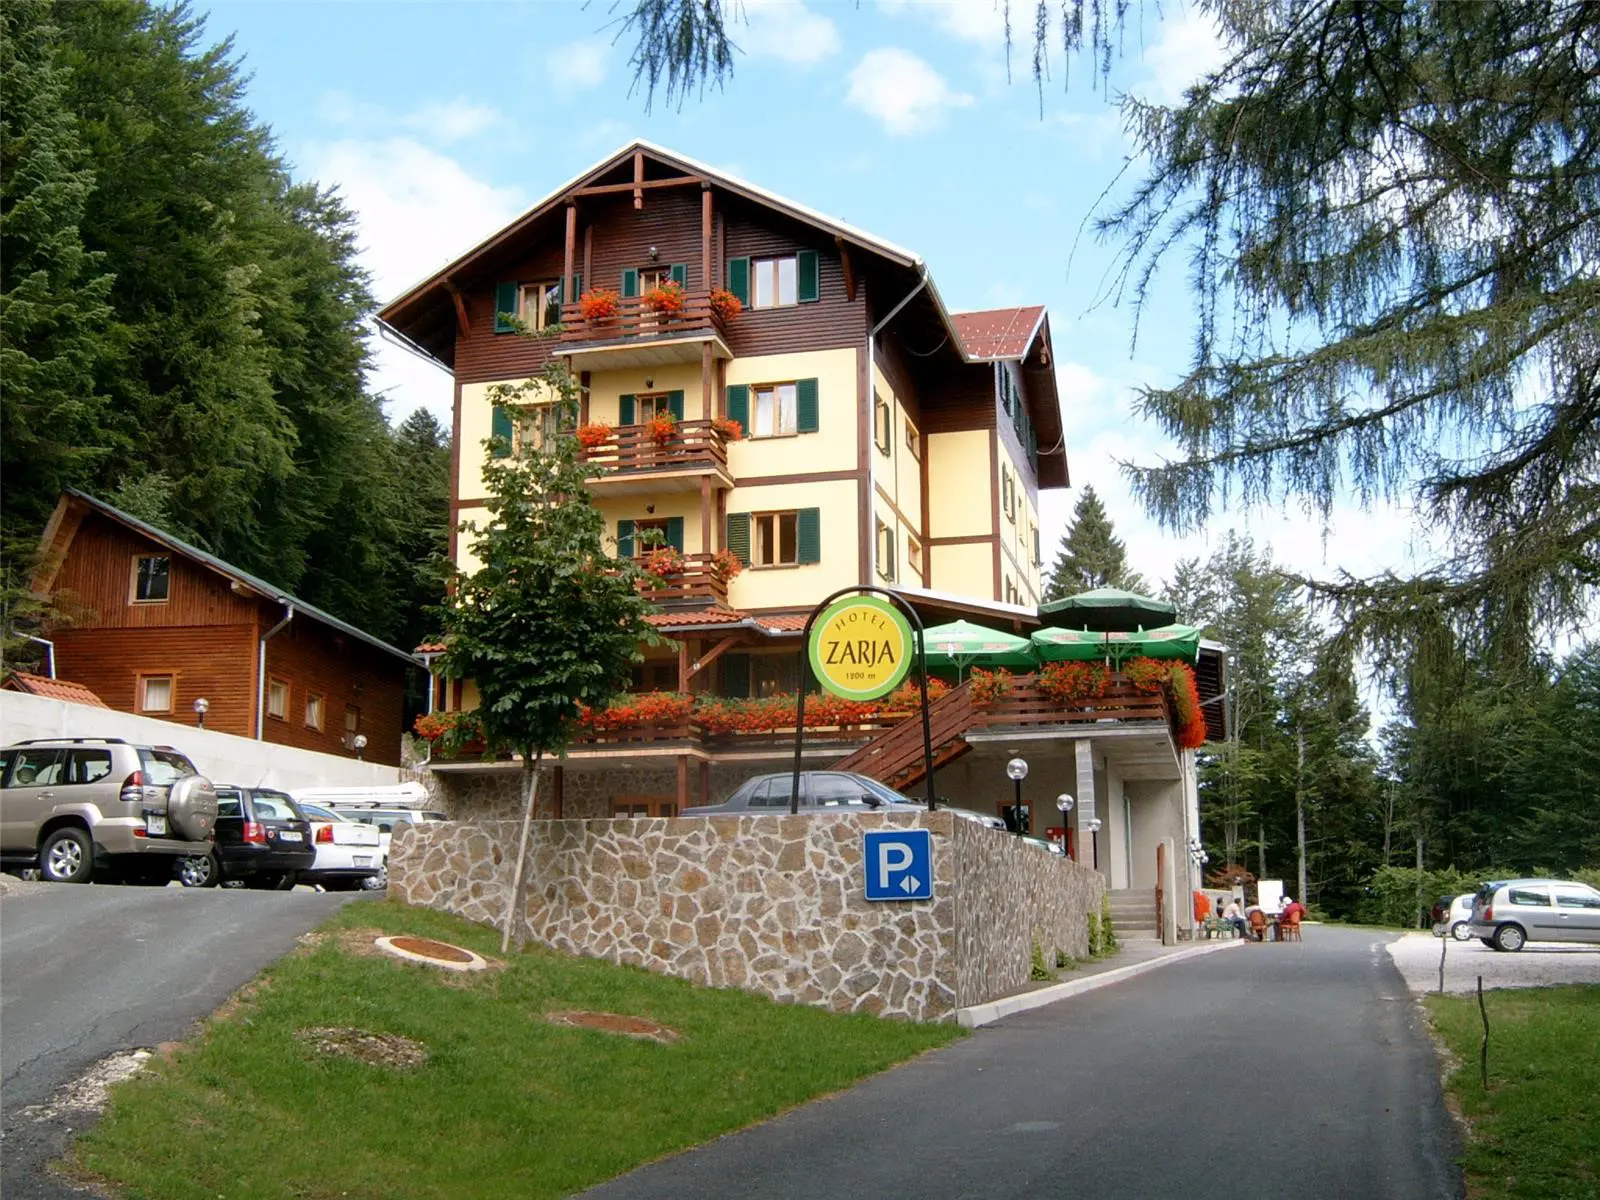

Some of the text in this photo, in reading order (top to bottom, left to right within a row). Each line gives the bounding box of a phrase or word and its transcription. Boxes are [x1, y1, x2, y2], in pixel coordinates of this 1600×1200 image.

[835, 611, 887, 631] HOTEL
[825, 639, 895, 668] ZARJA
[846, 672, 865, 680] 1200
[879, 842, 913, 888] P
